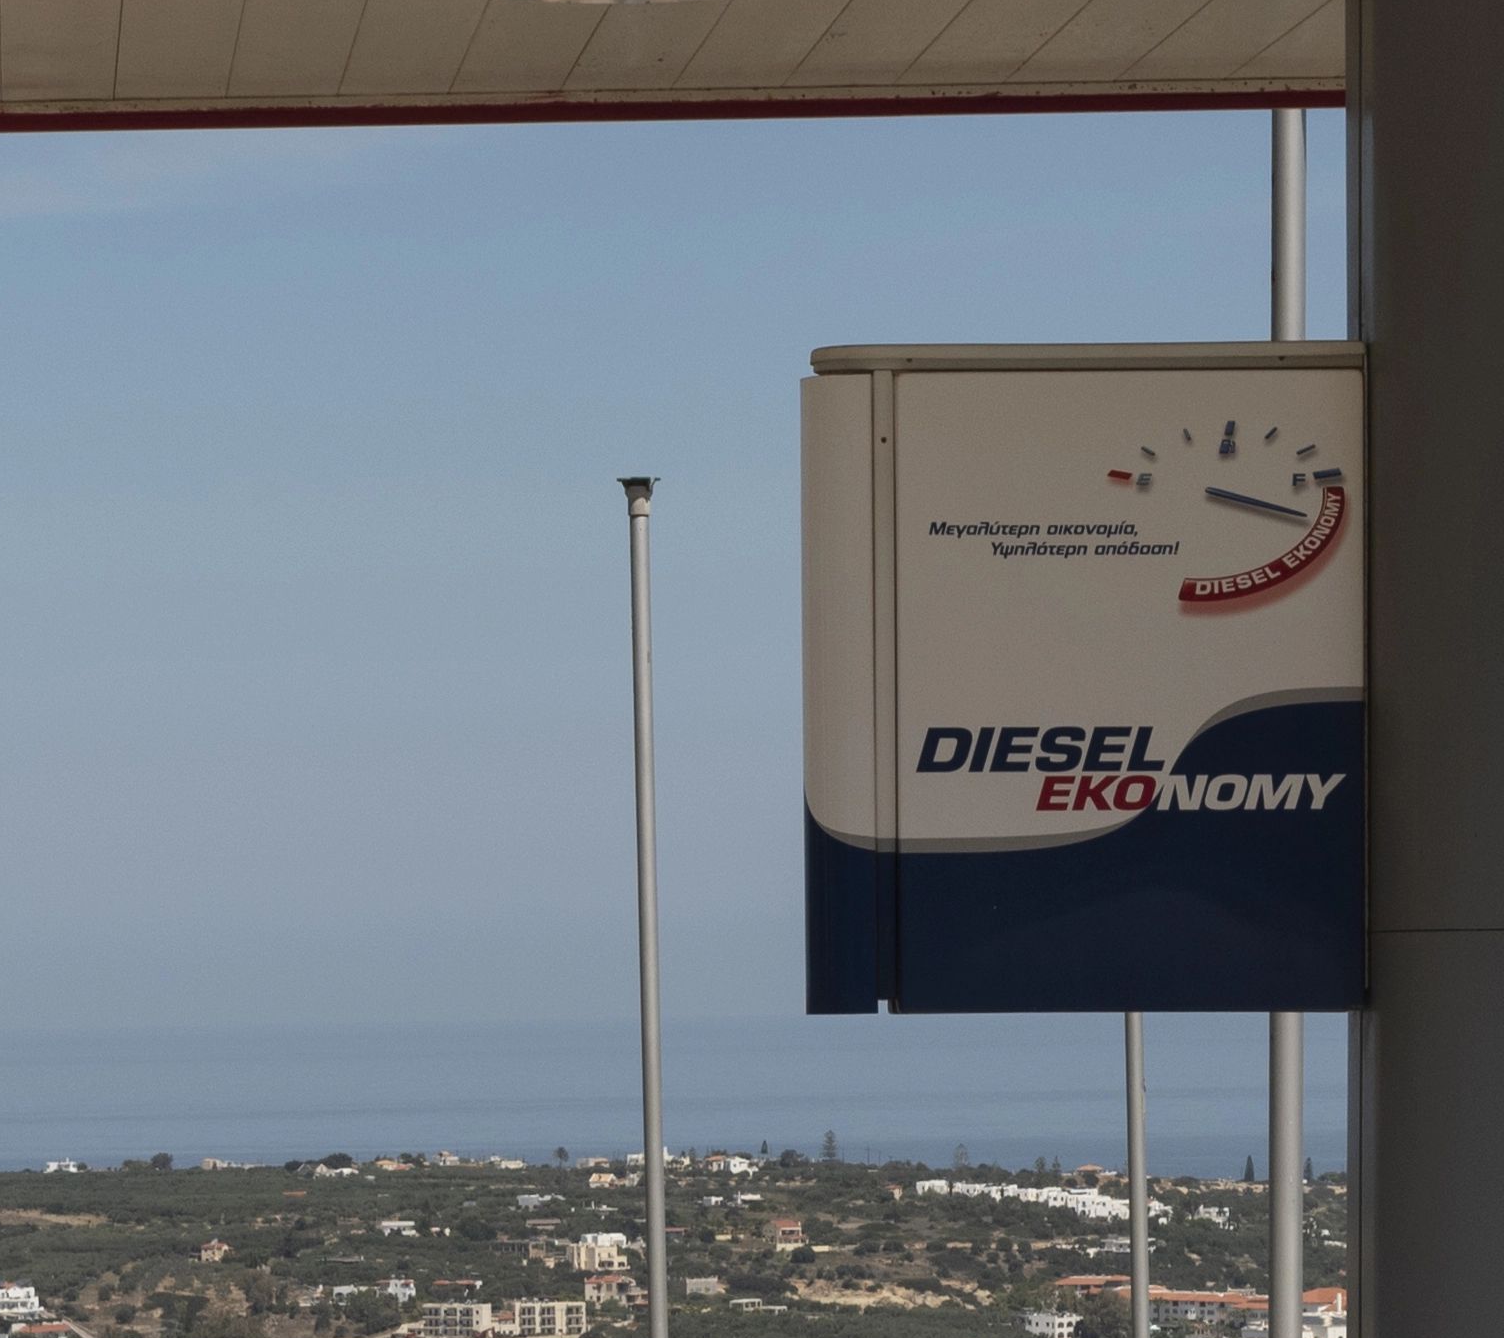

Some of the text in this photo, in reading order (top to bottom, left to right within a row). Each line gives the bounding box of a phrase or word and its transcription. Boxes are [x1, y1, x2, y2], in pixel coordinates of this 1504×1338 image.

[1292, 473, 1306, 486] F
[929, 520, 1138, 538] Μεγαλύτερη οικονομία,
[991, 540, 1180, 558] Υψηλότερη απόδοση!
[1194, 492, 1341, 596] DIESEL EKONOMY
[915, 725, 1166, 773] DIESEL
[1035, 773, 1346, 811] EKONOMY
